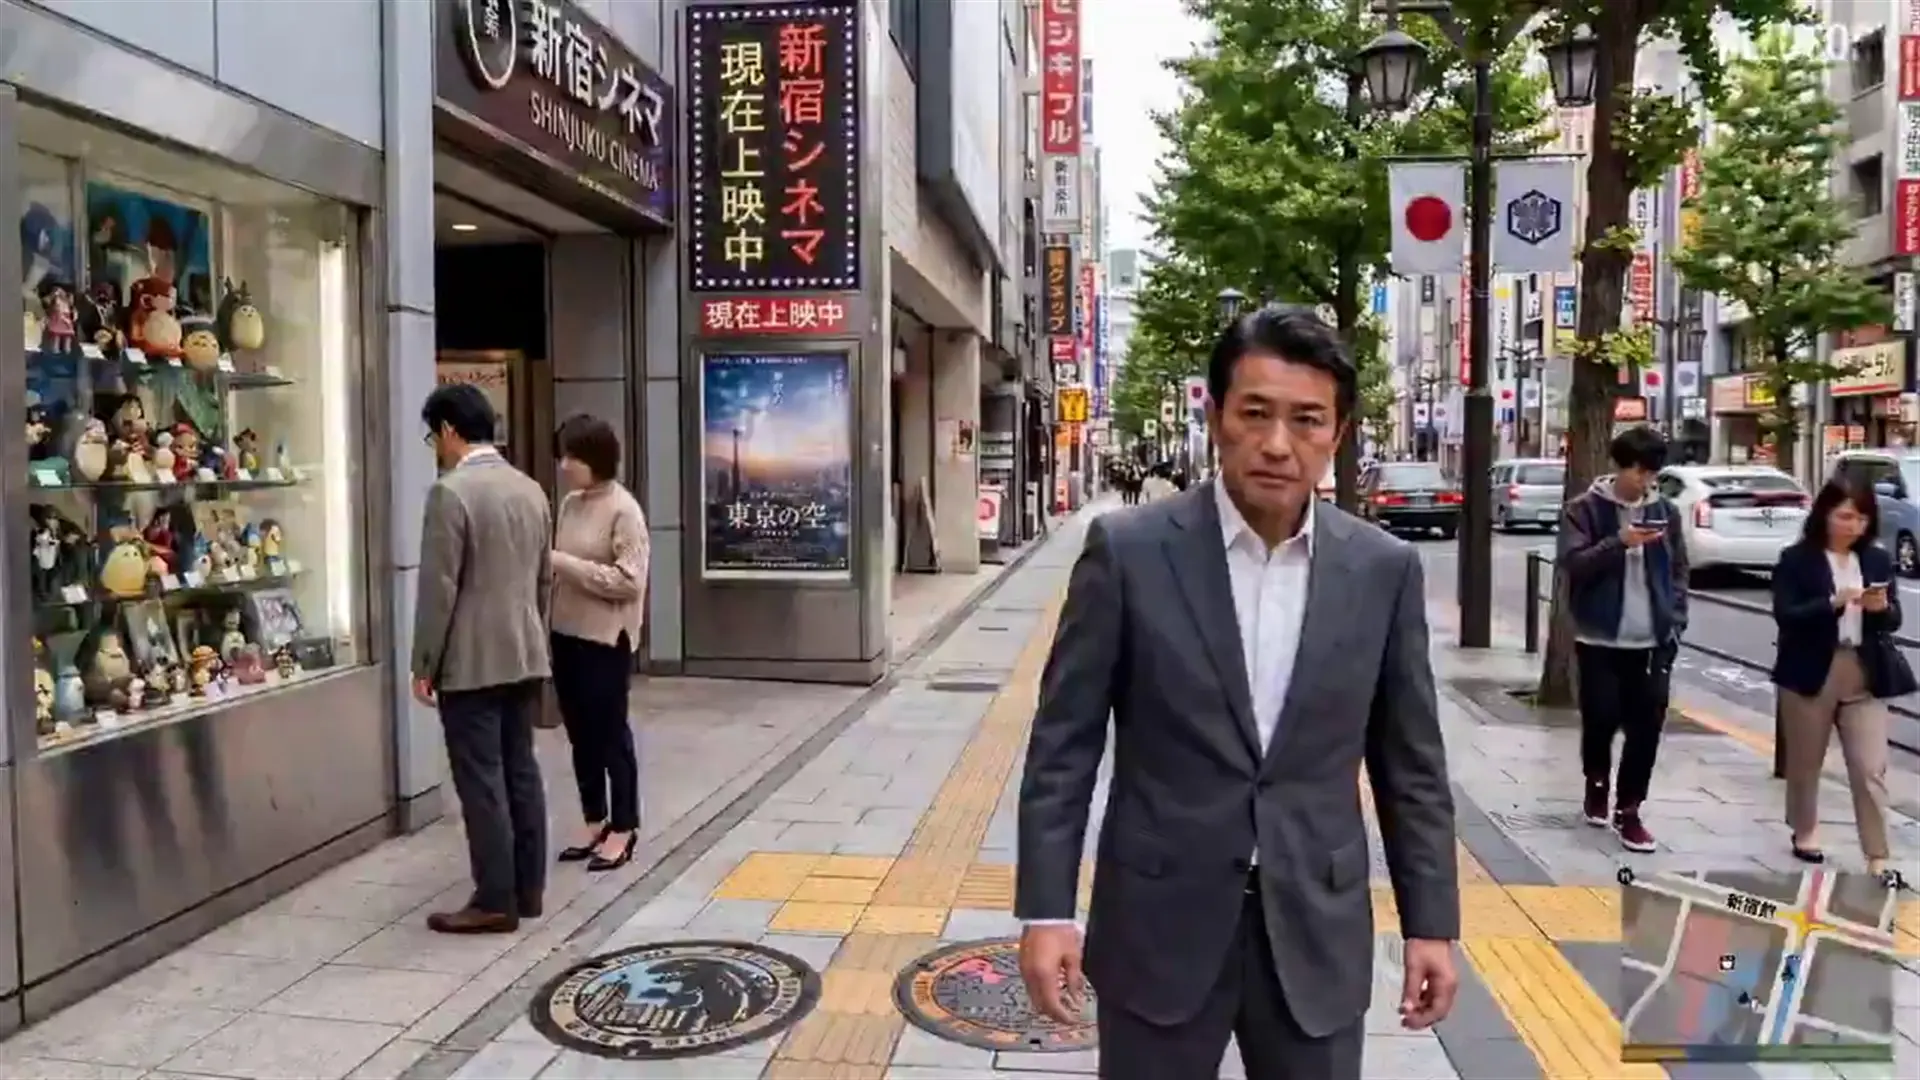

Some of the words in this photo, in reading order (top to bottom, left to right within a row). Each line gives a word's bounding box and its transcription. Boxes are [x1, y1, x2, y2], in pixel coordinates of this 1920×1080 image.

[530, 0, 665, 147] 新宿シネマ
[530, 90, 606, 164] SHINJUKU
[609, 139, 660, 193] CINEMA
[720, 41, 766, 273] 現在上映中
[779, 23, 827, 266] 新宿シネマ
[706, 300, 844, 330] 現在上映中
[725, 499, 827, 530] 東京の空
